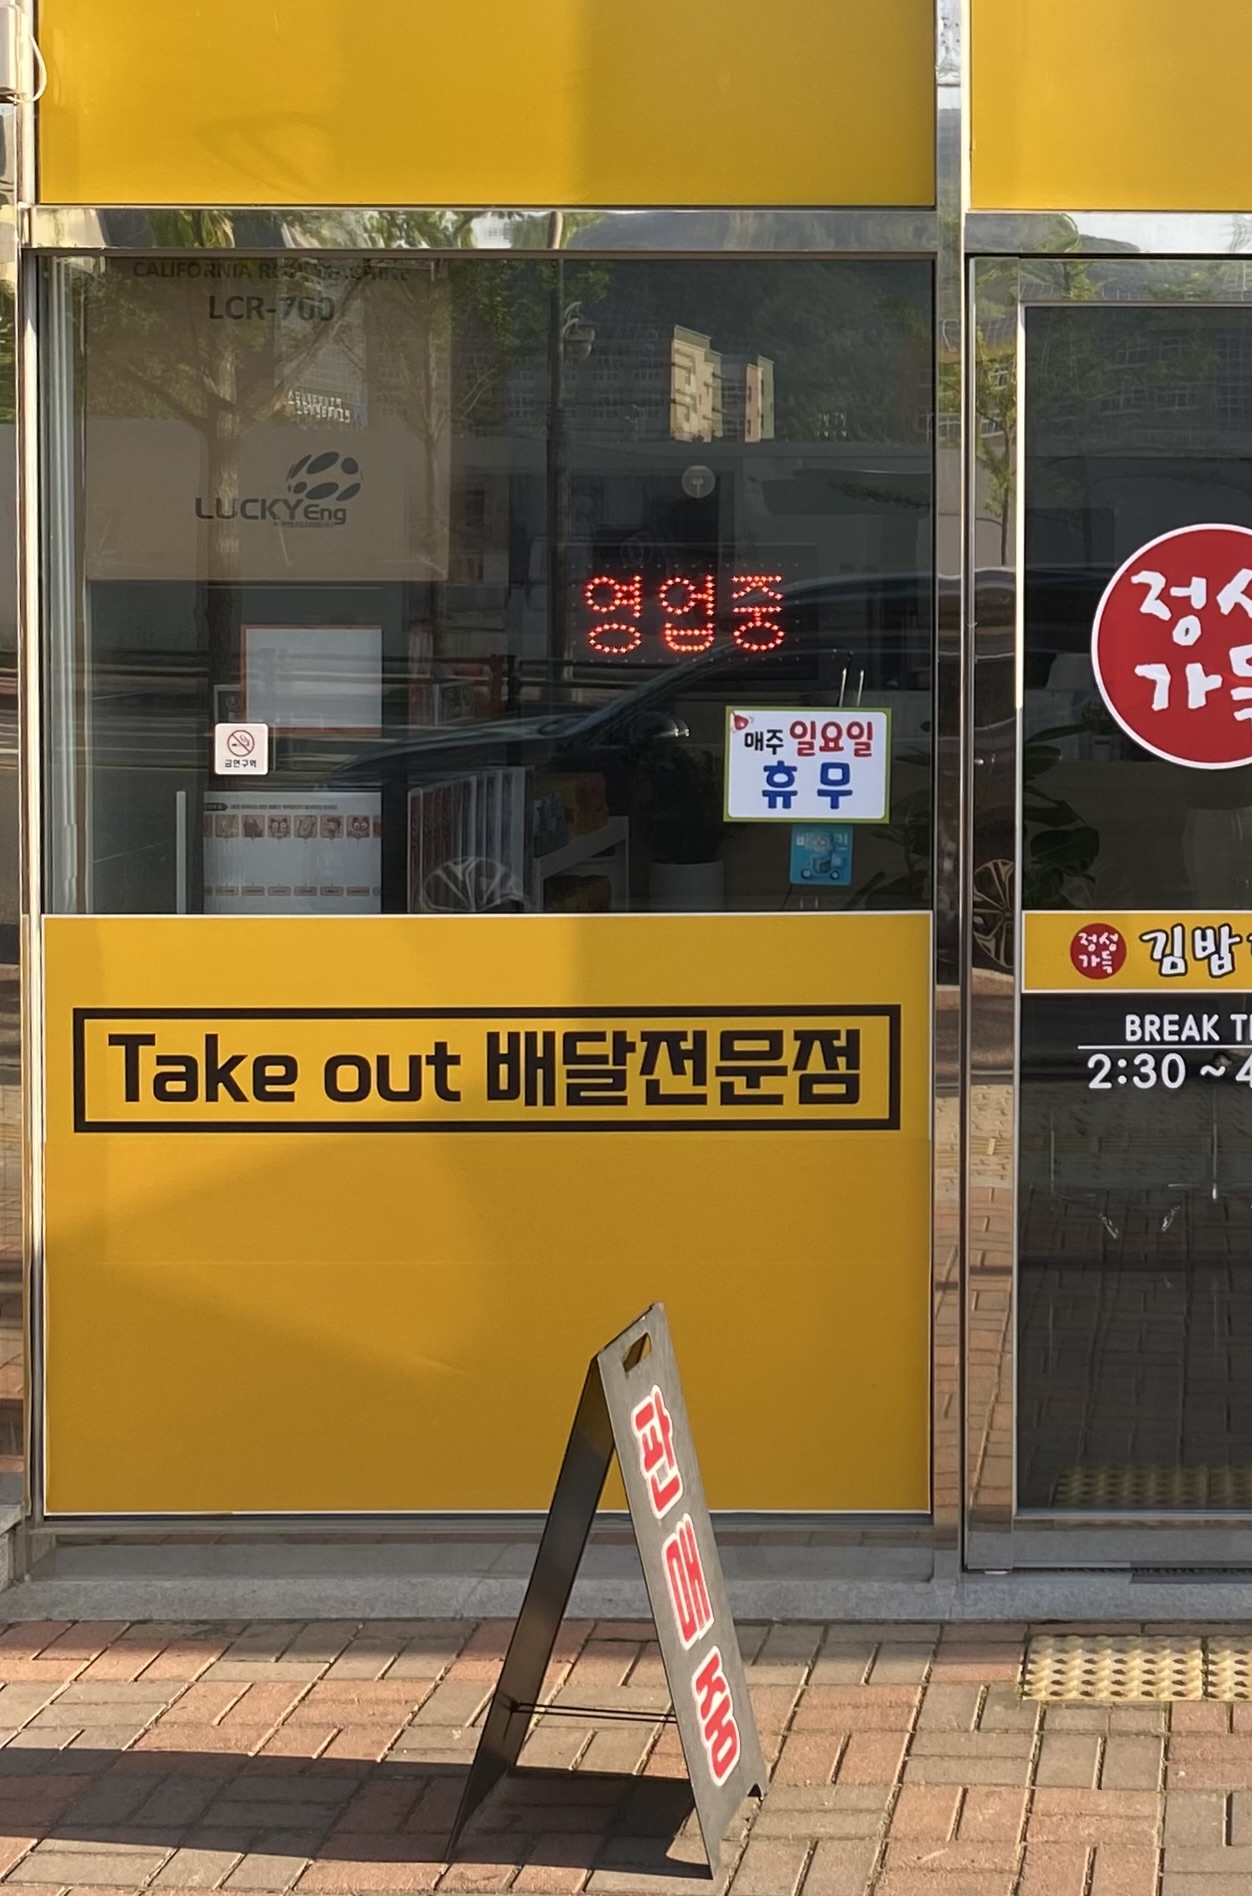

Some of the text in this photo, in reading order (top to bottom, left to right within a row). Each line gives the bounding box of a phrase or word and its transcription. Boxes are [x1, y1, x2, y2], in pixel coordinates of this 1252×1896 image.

[133, 261, 250, 280] CALIFORNIA
[584, 574, 787, 654] 영업중
[744, 720, 874, 757] 매주 일요일
[224, 758, 257, 768] 금연구역
[1077, 931, 1120, 948] 정성
[1078, 950, 1113, 974] 가득
[1125, 1013, 1220, 1042] BREAK
[108, 1029, 861, 1108] Take out 배달전문점
[632, 1384, 740, 1787] 판매중
